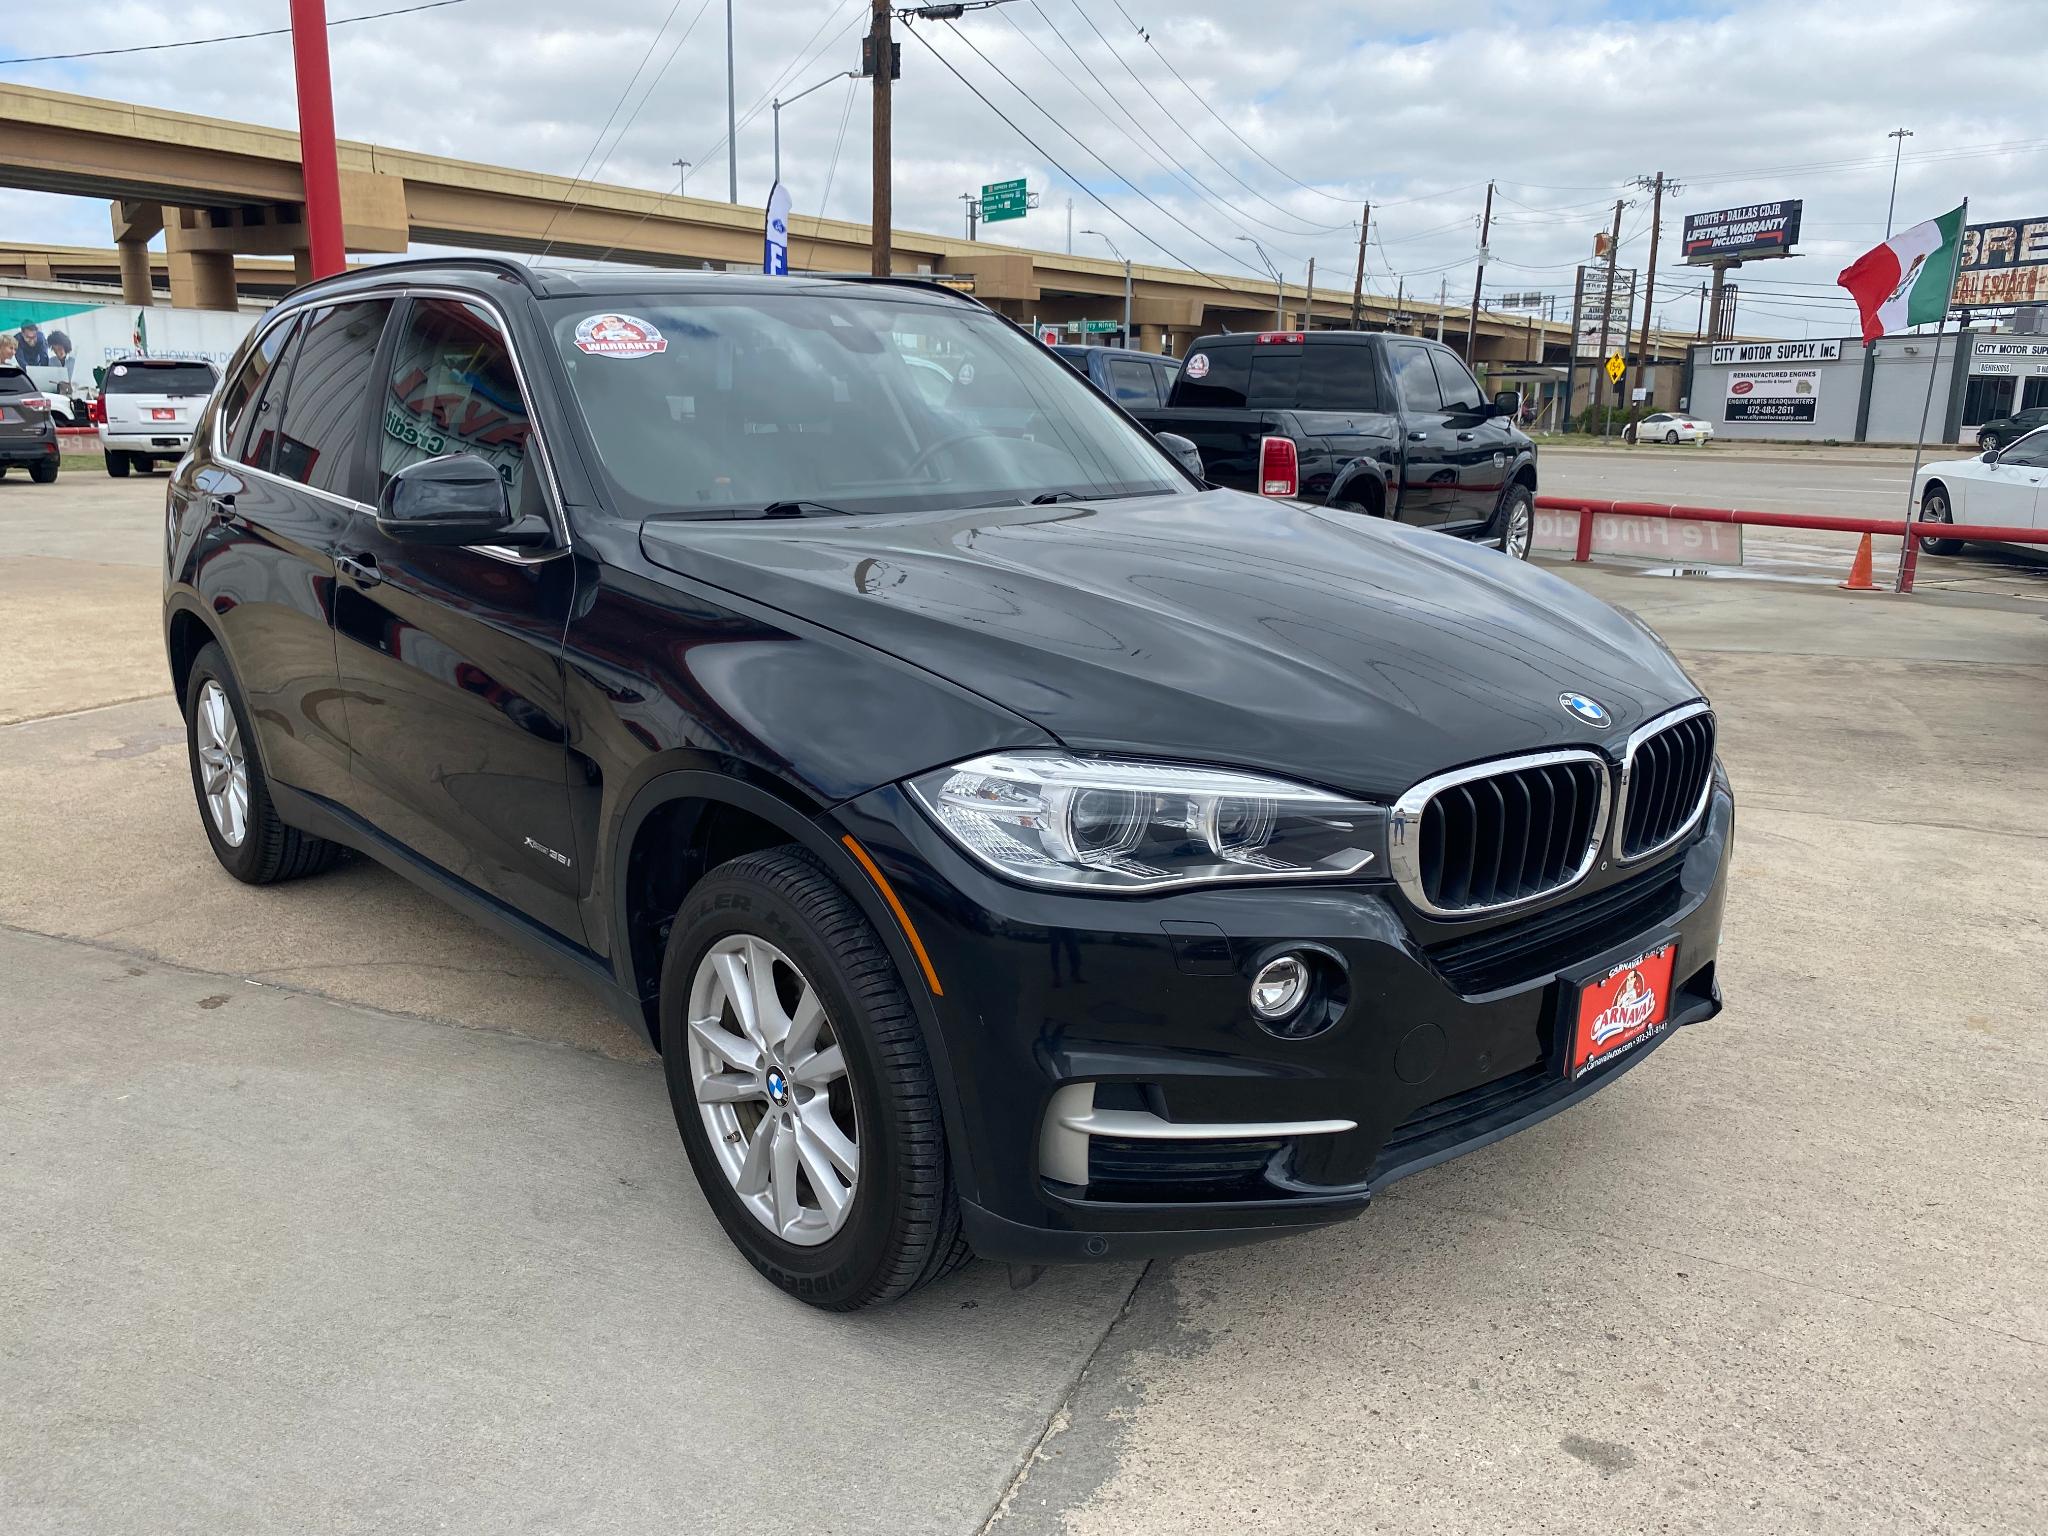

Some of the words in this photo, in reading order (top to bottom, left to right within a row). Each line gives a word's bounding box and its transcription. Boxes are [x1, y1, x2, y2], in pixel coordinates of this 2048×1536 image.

[1693, 212, 1720, 227] NORTH
[1727, 206, 1758, 221] DALLAS
[1759, 203, 1781, 216] CDJR
[1686, 225, 1729, 241] LIFETIME
[1729, 216, 1788, 236] WARRANTY
[1711, 233, 1757, 248] INCLUDED!
[585, 342, 659, 351] WARRANTY
[1714, 347, 1735, 361] CITY
[1740, 346, 1772, 360] MOTOR
[1977, 344, 1997, 353] CITY
[1999, 345, 2028, 354] MOTOR
[1746, 405, 1794, 414] 972-484-2611
[1608, 954, 1645, 977] CARNAVAL
[1591, 997, 1655, 1041] CARNAVAL
